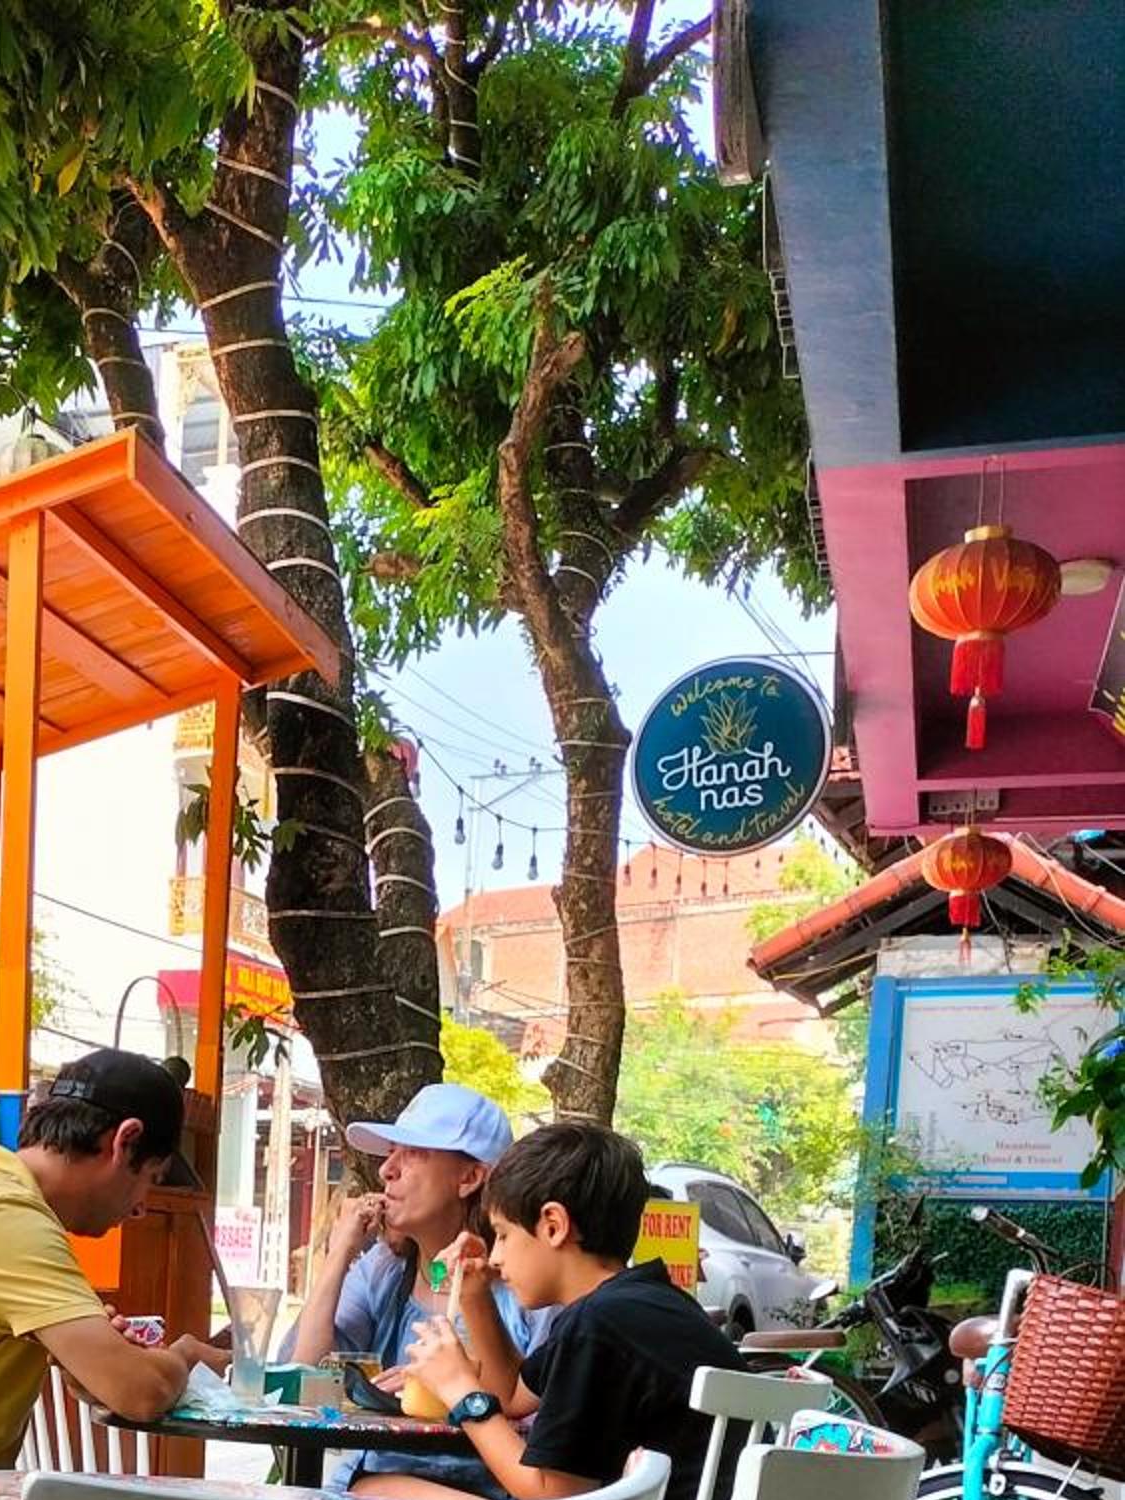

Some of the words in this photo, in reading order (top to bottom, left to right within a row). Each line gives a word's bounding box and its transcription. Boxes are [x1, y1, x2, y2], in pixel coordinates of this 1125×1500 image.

[657, 742, 791, 791] Hanah
[653, 796, 701, 839] hotel
[701, 818, 753, 845] and
[749, 781, 805, 835] travel
[700, 784, 764, 811] nas
[663, 1213, 692, 1240] RENT
